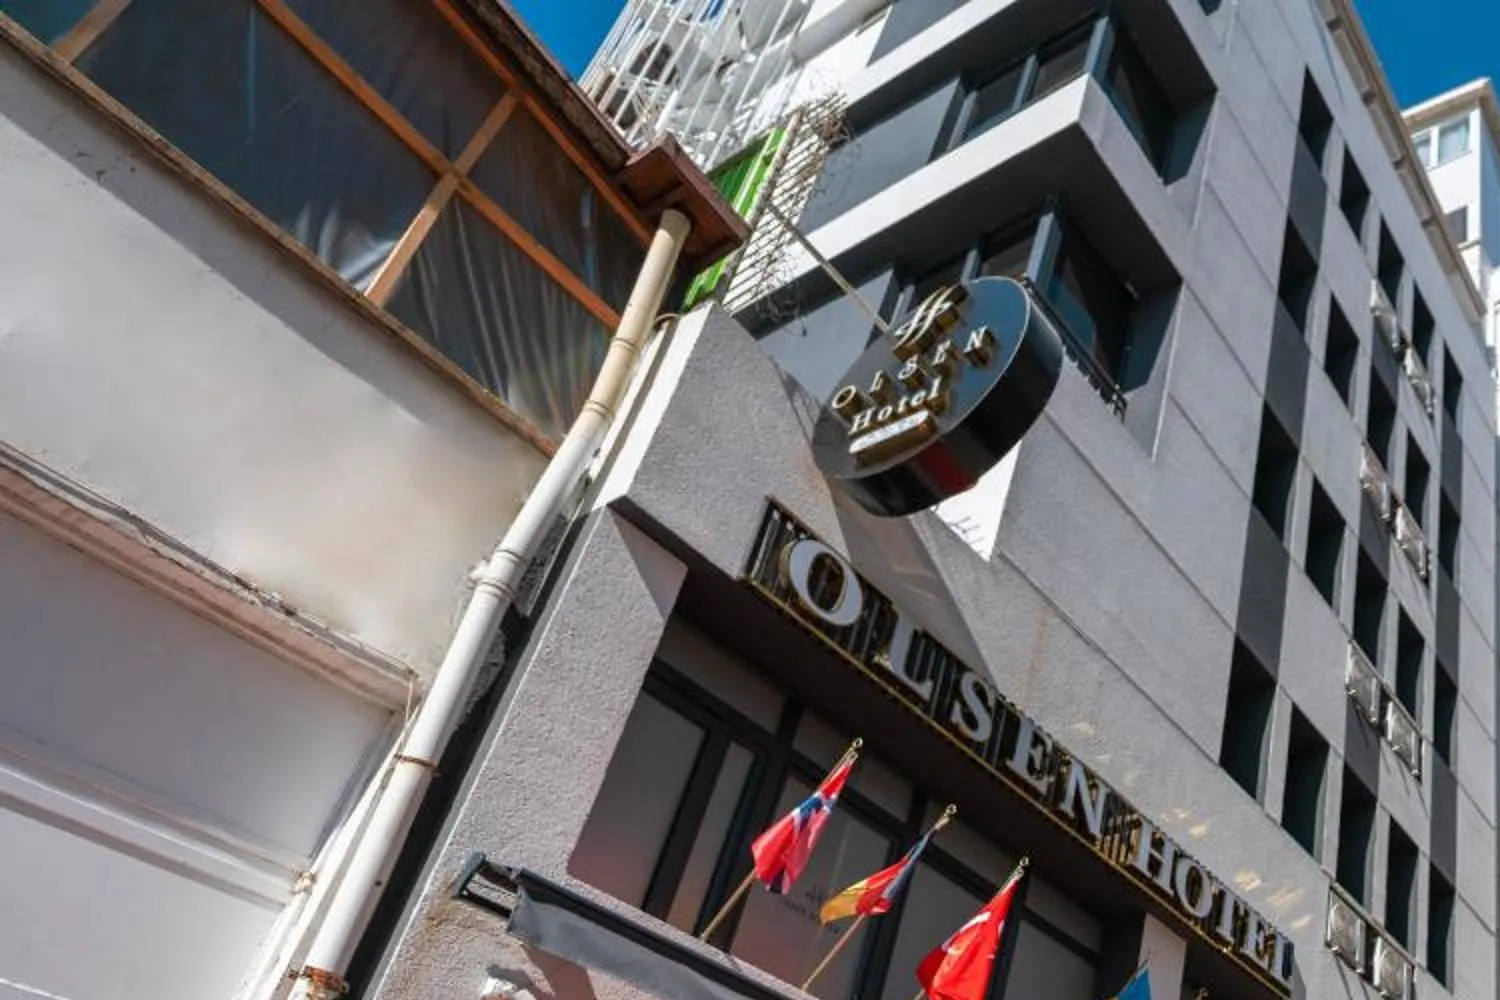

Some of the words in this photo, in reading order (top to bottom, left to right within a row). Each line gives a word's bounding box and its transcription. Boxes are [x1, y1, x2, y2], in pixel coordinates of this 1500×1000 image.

[832, 325, 988, 408] OLSEN
[848, 375, 943, 436] Hotel
[783, 537, 1113, 839] OLSEN
[1128, 818, 1295, 989] HOTEL
